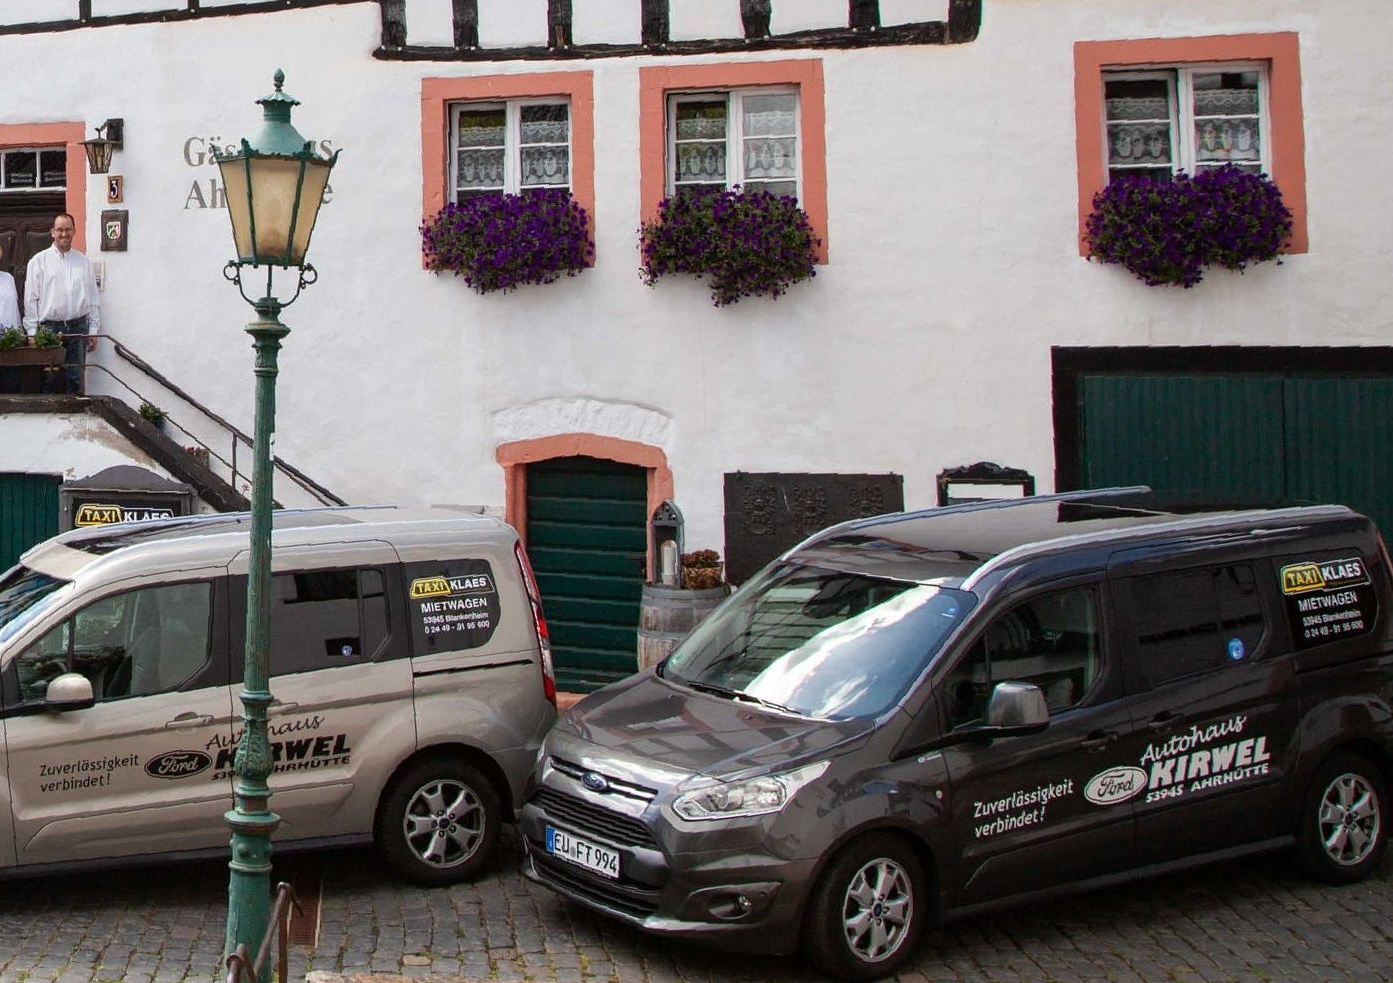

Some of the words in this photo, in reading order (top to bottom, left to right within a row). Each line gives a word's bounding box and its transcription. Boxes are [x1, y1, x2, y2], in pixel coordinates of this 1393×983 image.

[110, 180, 118, 198] 3
[84, 510, 115, 522] TAXI
[417, 582, 444, 593] TAXI
[450, 578, 486, 590] KLAES
[1287, 569, 1318, 586] TAXI
[1321, 562, 1361, 580] KLAES
[421, 597, 487, 612] MIETWAGEN
[1298, 590, 1357, 612] MIETWAGEN
[215, 734, 351, 770] KRWEL
[1140, 715, 1247, 766] Autohaus
[40, 754, 139, 776] Zuverlässigkeit
[158, 755, 199, 774] Ford
[1149, 736, 1271, 789] KIRWEL
[40, 773, 110, 792] verbindet!
[1097, 772, 1134, 797] Ford
[1146, 785, 1184, 803] 53945
[1191, 763, 1269, 792] AHRHÜTTE
[974, 779, 1074, 818] Zuverlässigkeit
[975, 806, 1046, 838] verbindet!
[555, 833, 570, 853] EU
[577, 842, 592, 863] FT
[595, 849, 617, 873] 994
